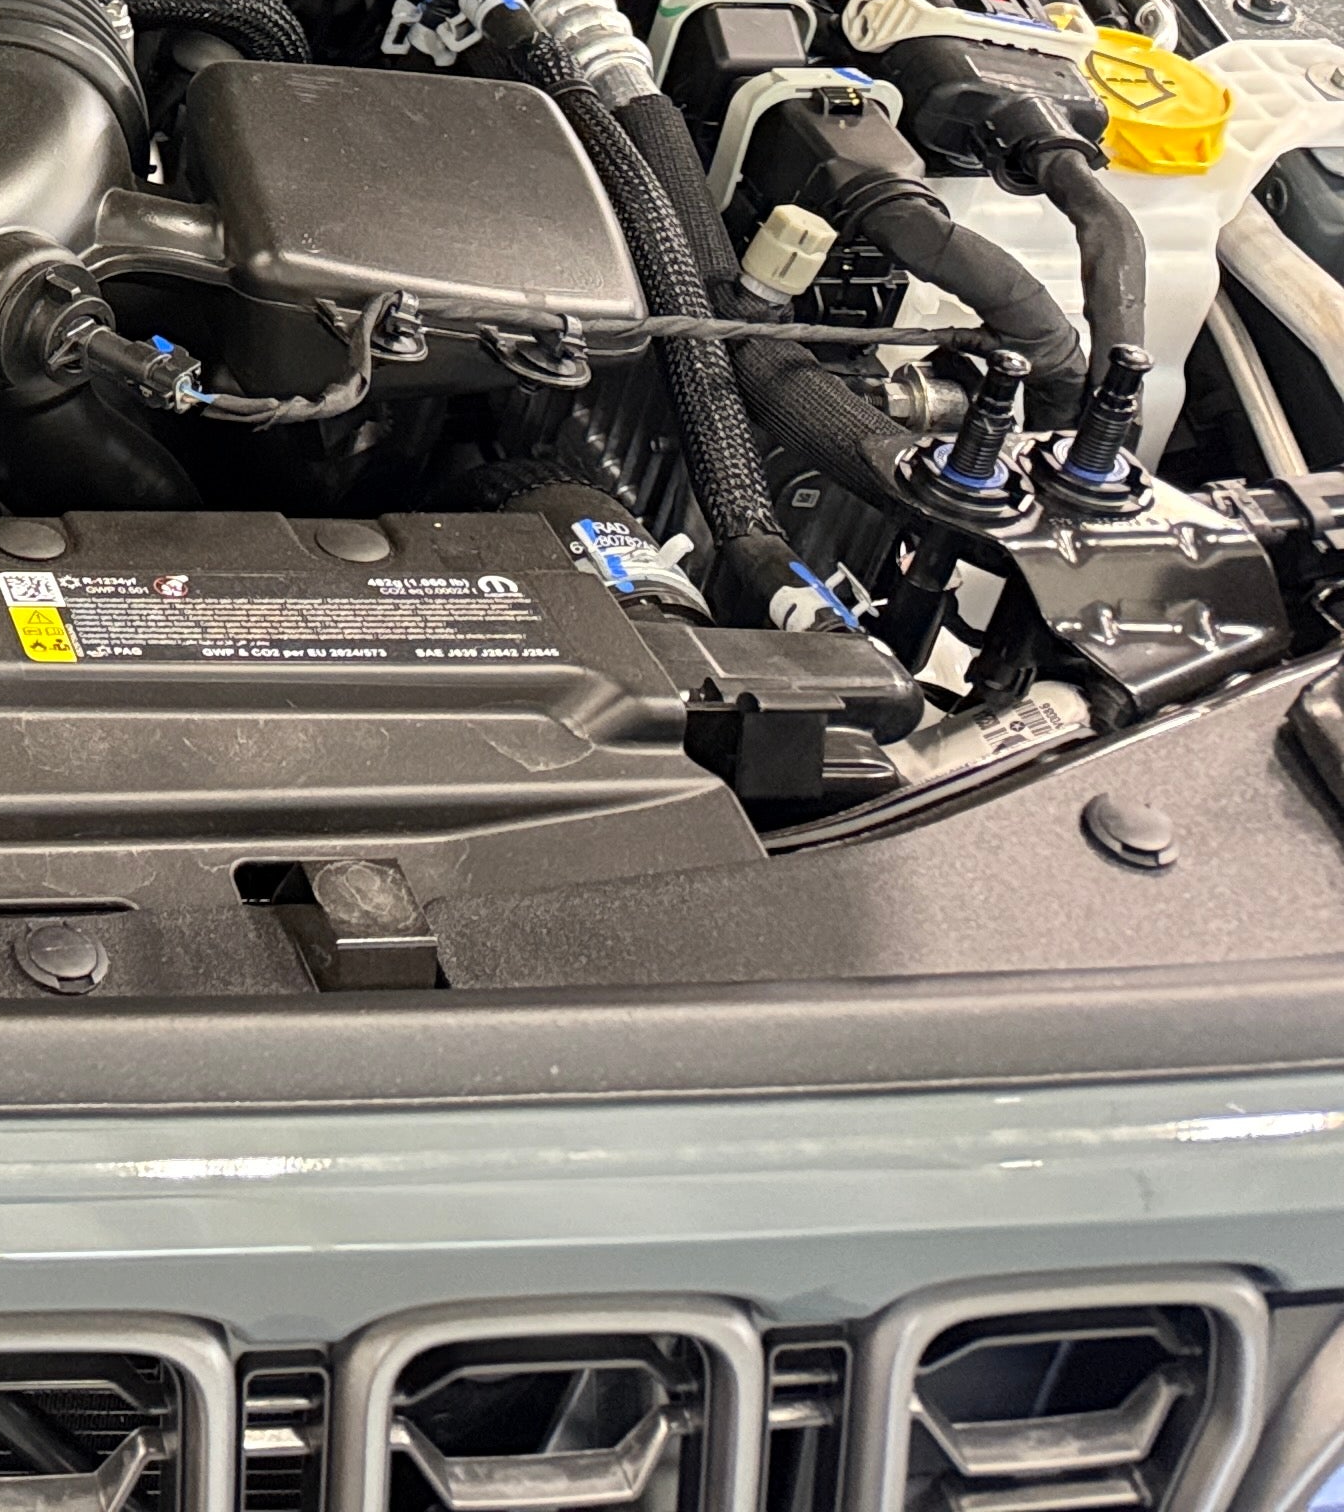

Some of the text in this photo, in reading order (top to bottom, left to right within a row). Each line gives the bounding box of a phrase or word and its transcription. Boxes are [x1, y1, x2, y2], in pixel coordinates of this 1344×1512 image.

[592, 521, 630, 535] RAD
[113, 646, 143, 657] PAG
[202, 648, 235, 658] GWP
[250, 648, 281, 658] CO2
[414, 648, 445, 658] SAE
